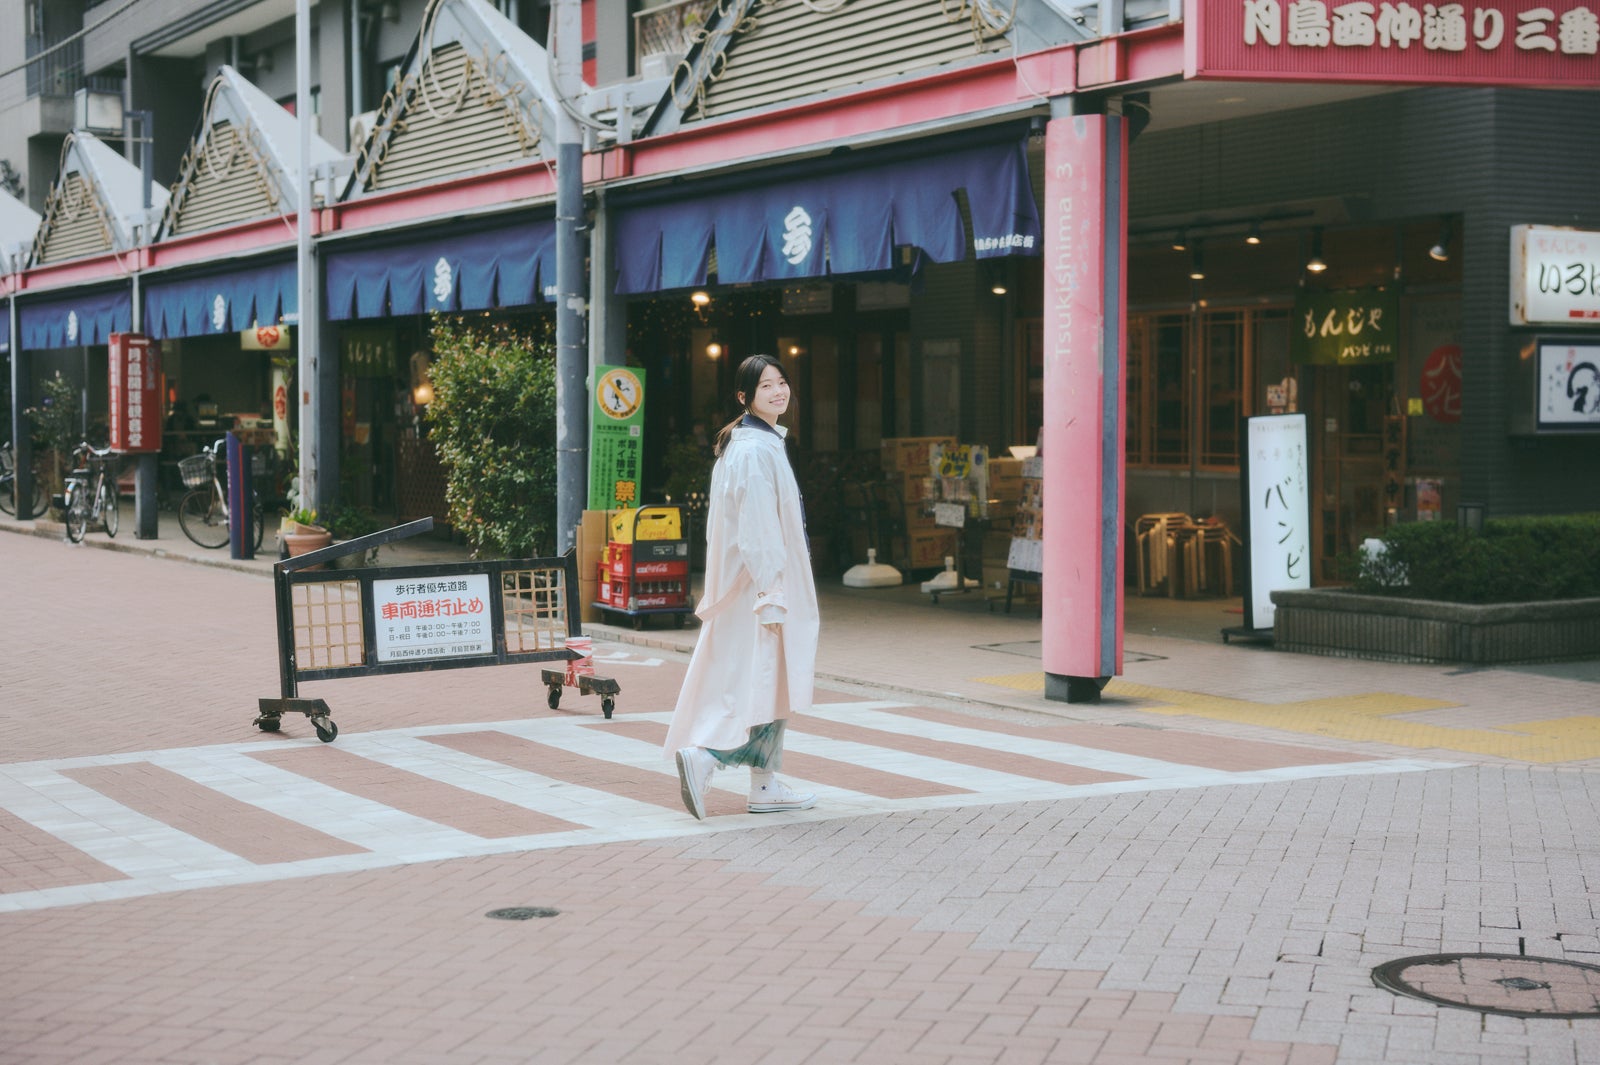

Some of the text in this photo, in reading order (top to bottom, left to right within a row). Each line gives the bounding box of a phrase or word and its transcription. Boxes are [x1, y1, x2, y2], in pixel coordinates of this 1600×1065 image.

[1056, 162, 1073, 359] Tsukishima 3
[1265, 477, 1305, 579] バンビ
[381, 596, 484, 620] 車両通行止め
[395, 581, 468, 595] 歩行者優先道路
